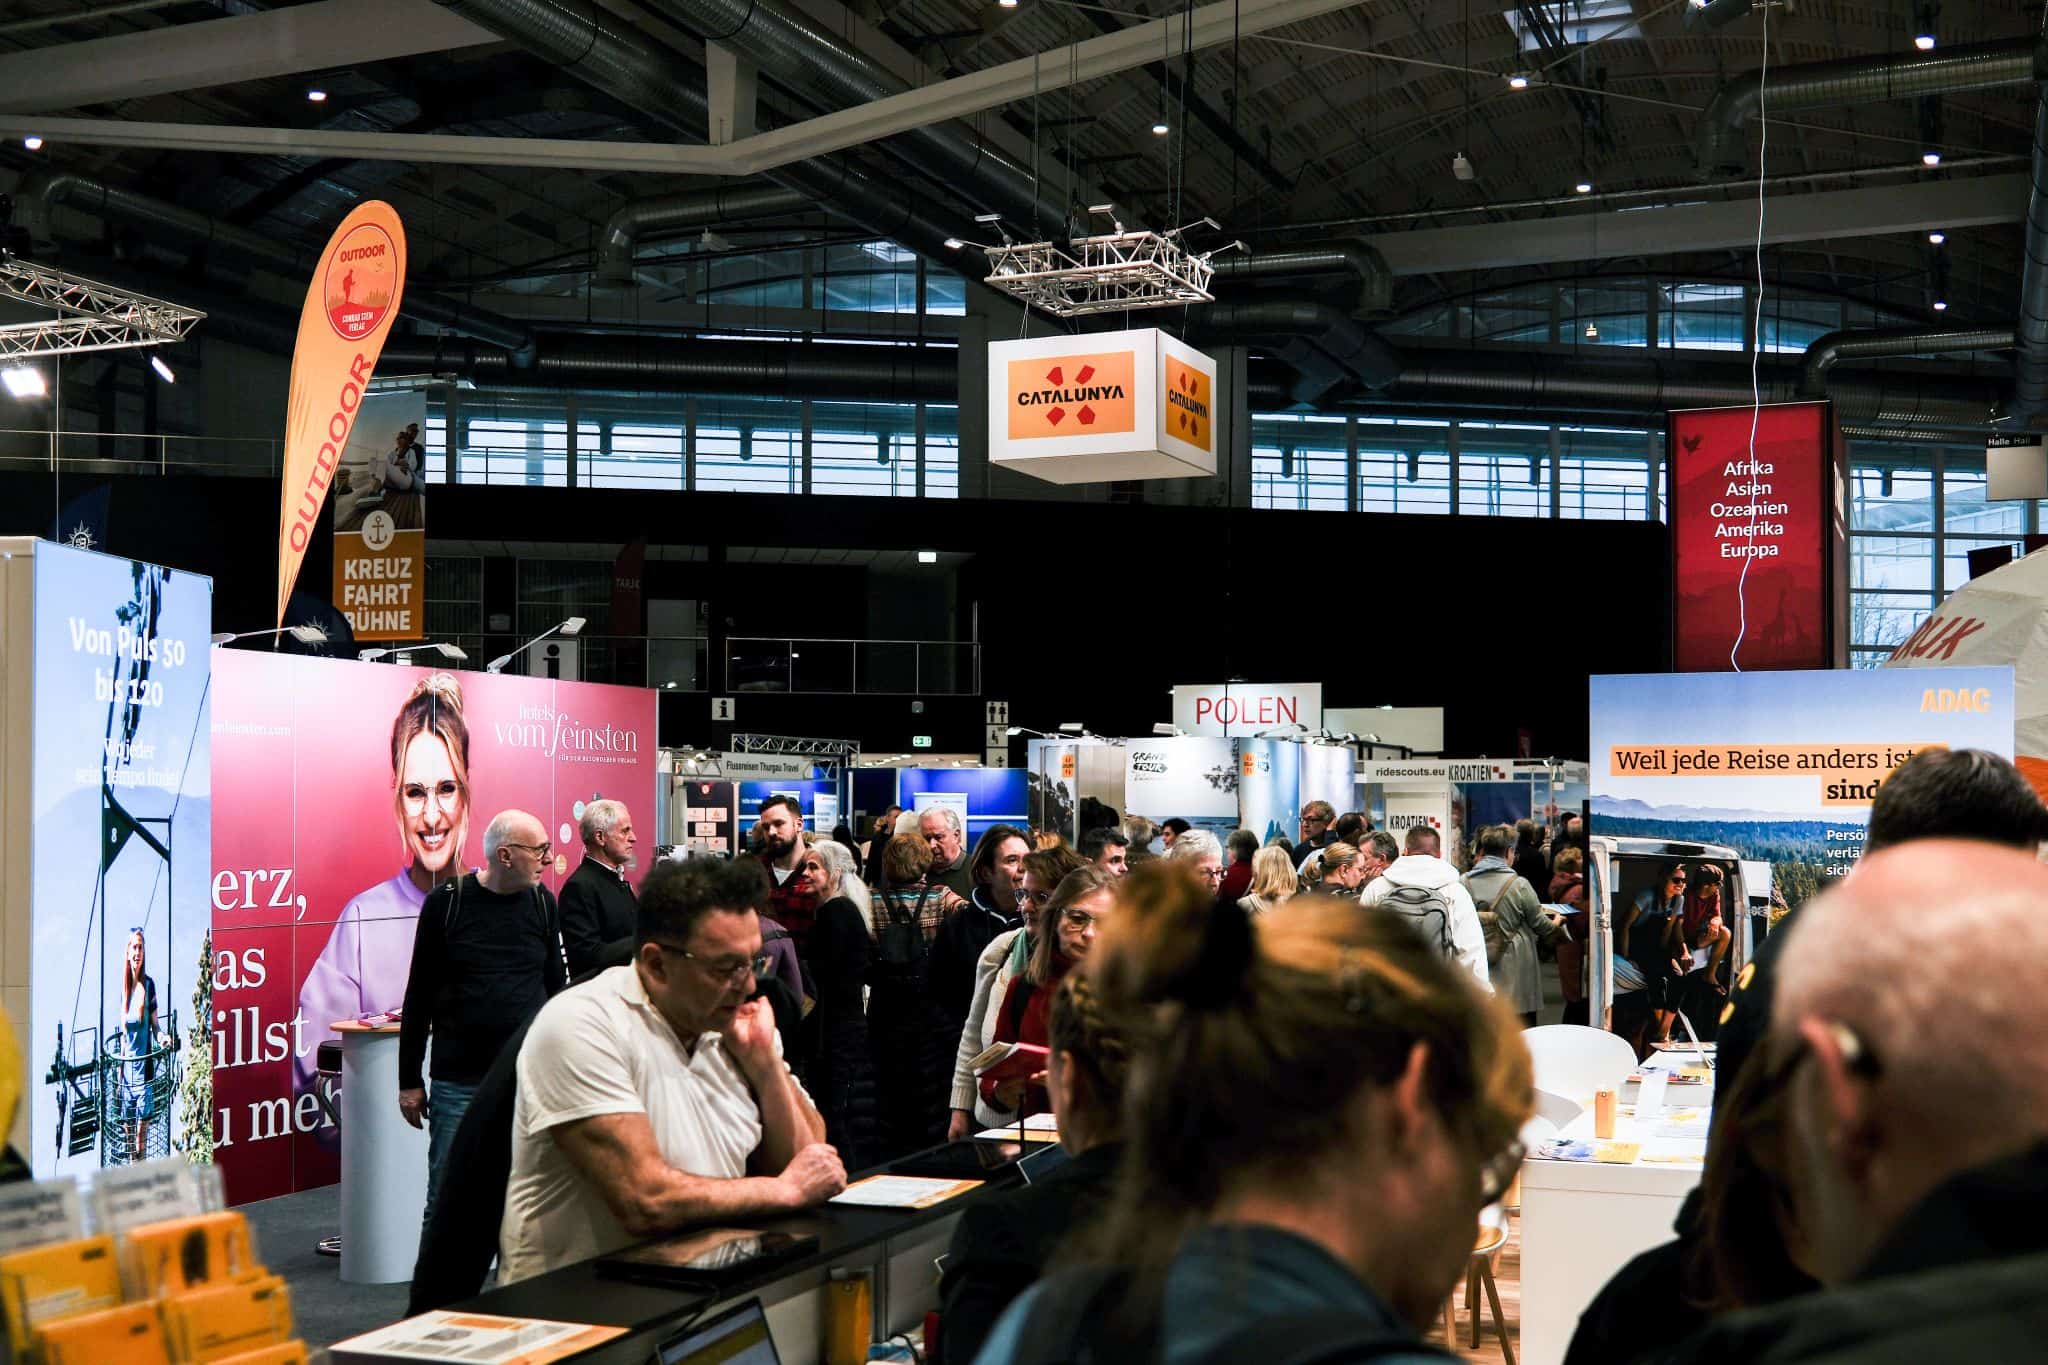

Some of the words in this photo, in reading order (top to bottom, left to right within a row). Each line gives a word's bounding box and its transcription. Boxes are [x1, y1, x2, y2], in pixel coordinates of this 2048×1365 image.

[341, 244, 386, 263] OUTDOOR
[1017, 385, 1125, 406] CATALUNYA
[1169, 388, 1208, 419] CATALUNYA
[289, 352, 374, 553] OUTDOOR
[1988, 438, 2010, 447] Halle
[1723, 460, 1774, 476] Afrika
[1725, 482, 1772, 496] Asien
[1710, 501, 1789, 517] Ozeanien
[1714, 521, 1784, 537] Amerika
[1720, 542, 1779, 559] Europa
[343, 556, 413, 580] KREUZ
[343, 584, 412, 606] FAHRT
[344, 607, 411, 631] BÜHNE
[69, 617, 112, 656] Von
[117, 625, 159, 662] Puls
[162, 638, 186, 669] 50
[95, 667, 124, 703] bis
[127, 678, 164, 708] 120
[1195, 696, 1298, 725] POLEN
[1920, 687, 1993, 714] ADAC
[519, 703, 554, 721] hotels
[783, 762, 799, 773] Travel
[1615, 749, 1668, 770] Weil
[1671, 749, 1721, 775] jede
[1726, 749, 1790, 770] Reise
[1796, 748, 1879, 769] anders
[1375, 767, 1446, 777] ridescouts.eu
[1448, 764, 1492, 781] KROATIEN
[1389, 815, 1429, 830] KROATIEN
